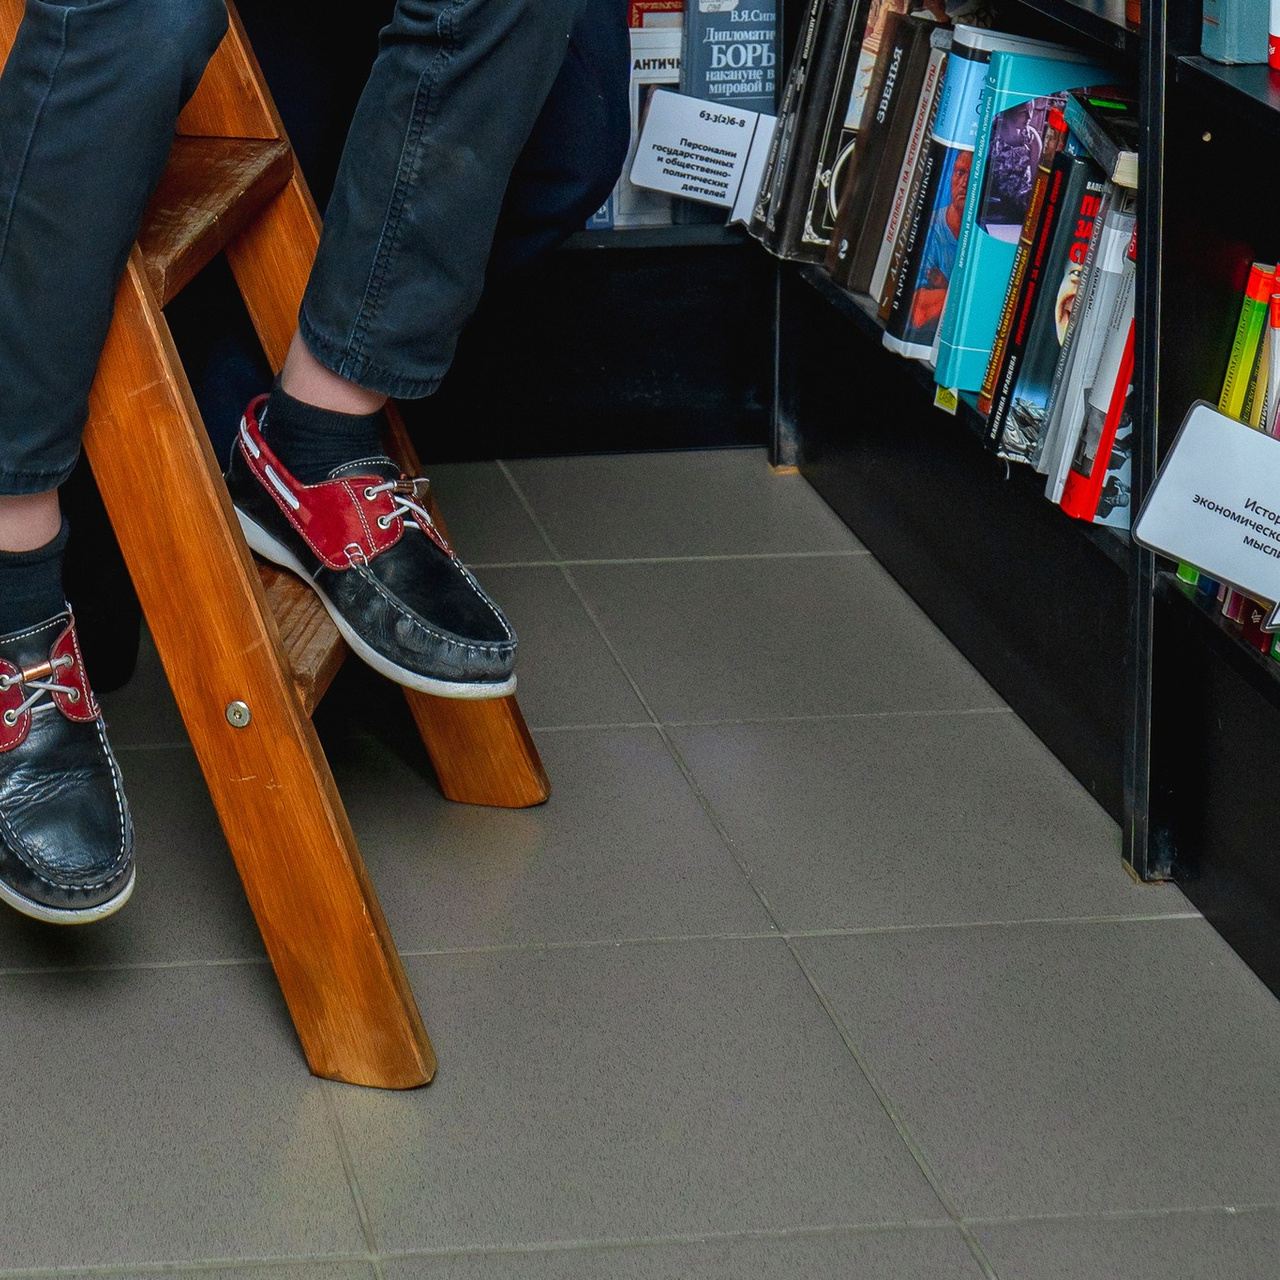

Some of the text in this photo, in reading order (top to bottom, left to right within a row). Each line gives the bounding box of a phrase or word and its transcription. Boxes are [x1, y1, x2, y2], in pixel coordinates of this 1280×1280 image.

[706, 68, 763, 81] накануне
[709, 81, 762, 94] мировой
[876, 46, 904, 125] ЗВЕНЬЯ
[699, 111, 745, 127] 63.3(2)6-8
[652, 143, 734, 169] государственных
[679, 138, 737, 159] Персоналии
[657, 155, 732, 178] и общественно-
[662, 168, 729, 189] политических
[681, 183, 726, 199] деятелей
